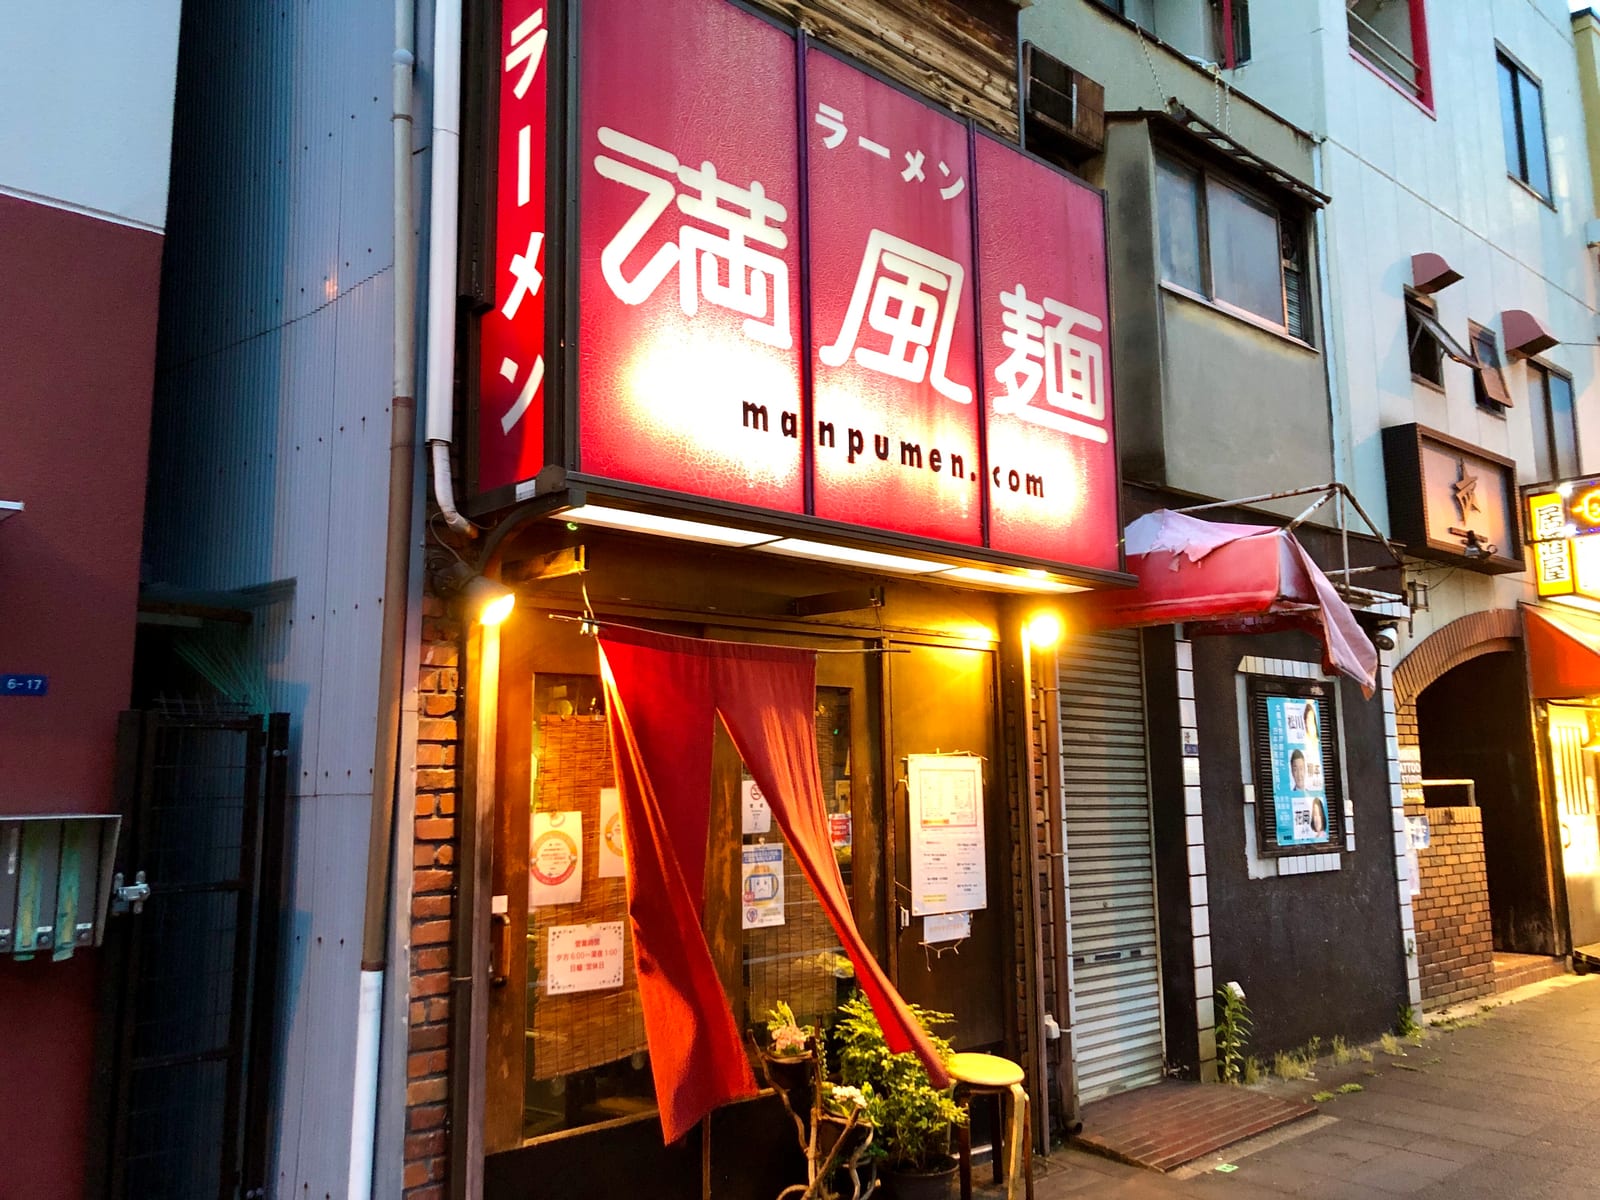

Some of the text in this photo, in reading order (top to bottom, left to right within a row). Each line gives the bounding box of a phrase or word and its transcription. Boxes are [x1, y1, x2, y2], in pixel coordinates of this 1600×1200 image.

[815, 102, 965, 201] ラーメン
[500, 7, 548, 436] ラーメン
[593, 126, 1108, 444] 満風麺
[742, 400, 1045, 498] manpumen.com
[7, 678, 43, 690] 6-17
[1400, 762, 1422, 774] ATTOO
